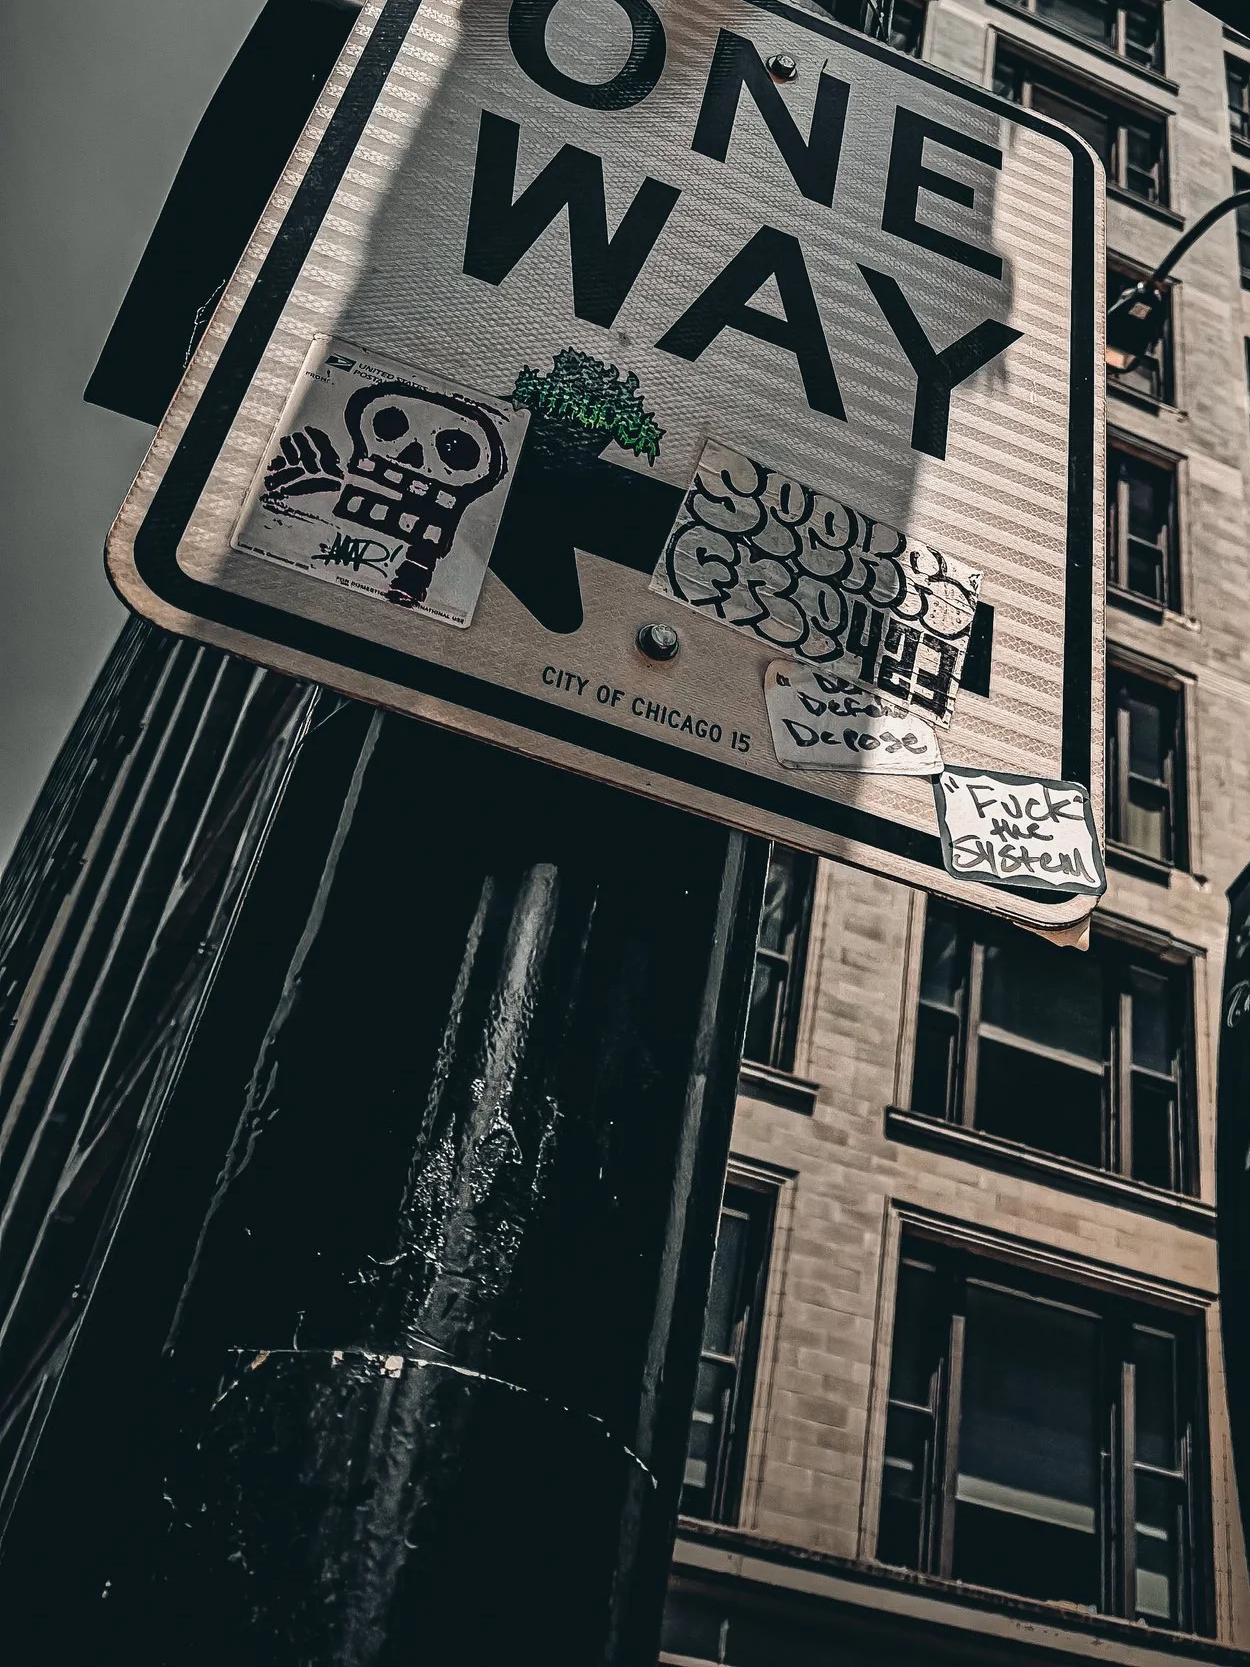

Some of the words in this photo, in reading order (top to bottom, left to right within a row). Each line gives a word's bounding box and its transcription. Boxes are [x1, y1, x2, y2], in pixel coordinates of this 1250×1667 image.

[462, 109, 1026, 461] WAY
[358, 362, 395, 380] UNITED
[542, 665, 590, 696] CITY
[596, 684, 625, 708] OF
[631, 696, 722, 743] CHICAGO
[730, 730, 751, 753] 15
